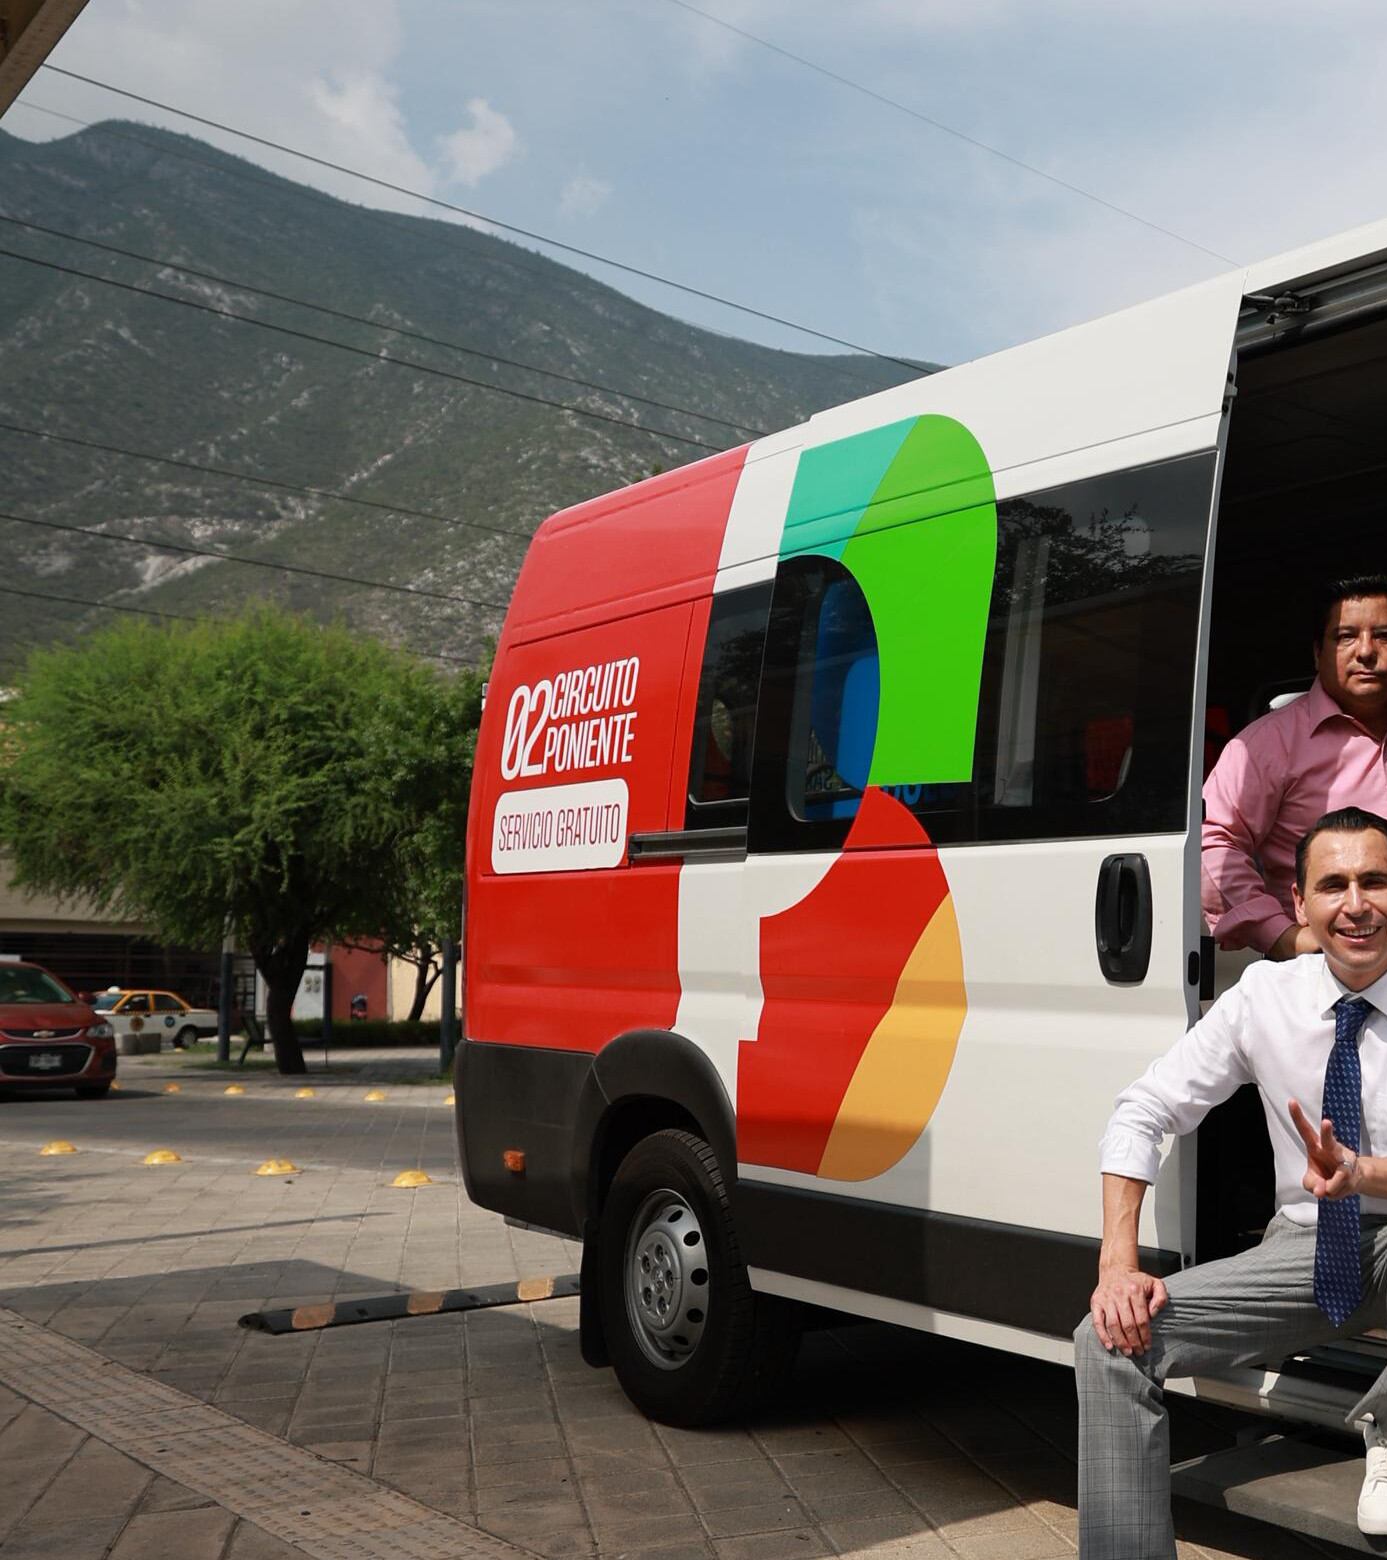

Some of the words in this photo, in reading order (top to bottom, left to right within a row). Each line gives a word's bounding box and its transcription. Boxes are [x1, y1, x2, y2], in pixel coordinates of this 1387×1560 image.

[549, 656, 640, 720] CIRCUITO
[500, 679, 553, 781] 02
[542, 712, 637, 774] PONIENTE
[498, 811, 552, 852] SERVICIO
[555, 803, 621, 847] GRATUITO
